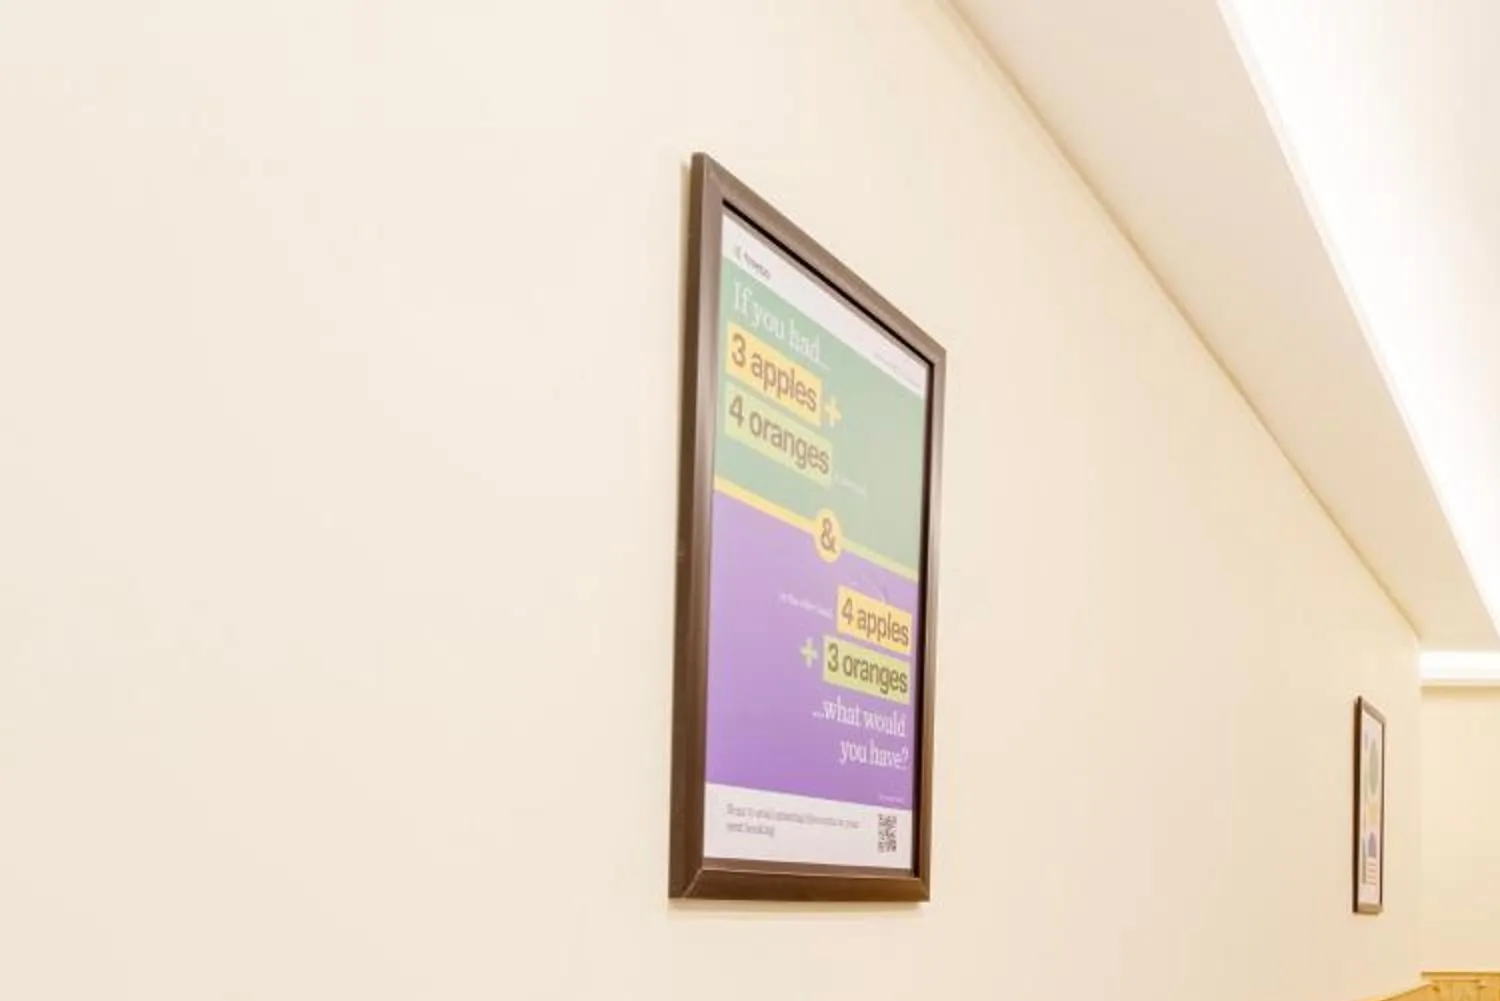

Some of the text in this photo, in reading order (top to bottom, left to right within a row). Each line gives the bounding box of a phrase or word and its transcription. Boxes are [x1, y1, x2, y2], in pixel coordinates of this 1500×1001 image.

[734, 281, 753, 316] If
[751, 302, 786, 339] you
[731, 332, 747, 369] 3
[751, 352, 818, 413] apples
[728, 394, 830, 475] 4 oranges
[820, 517, 837, 552] &
[841, 596, 854, 625] 4
[857, 608, 909, 646] apples
[827, 642, 839, 673] 3
[842, 654, 908, 695] oranges
[864, 710, 907, 737] would
[839, 739, 868, 765] you
